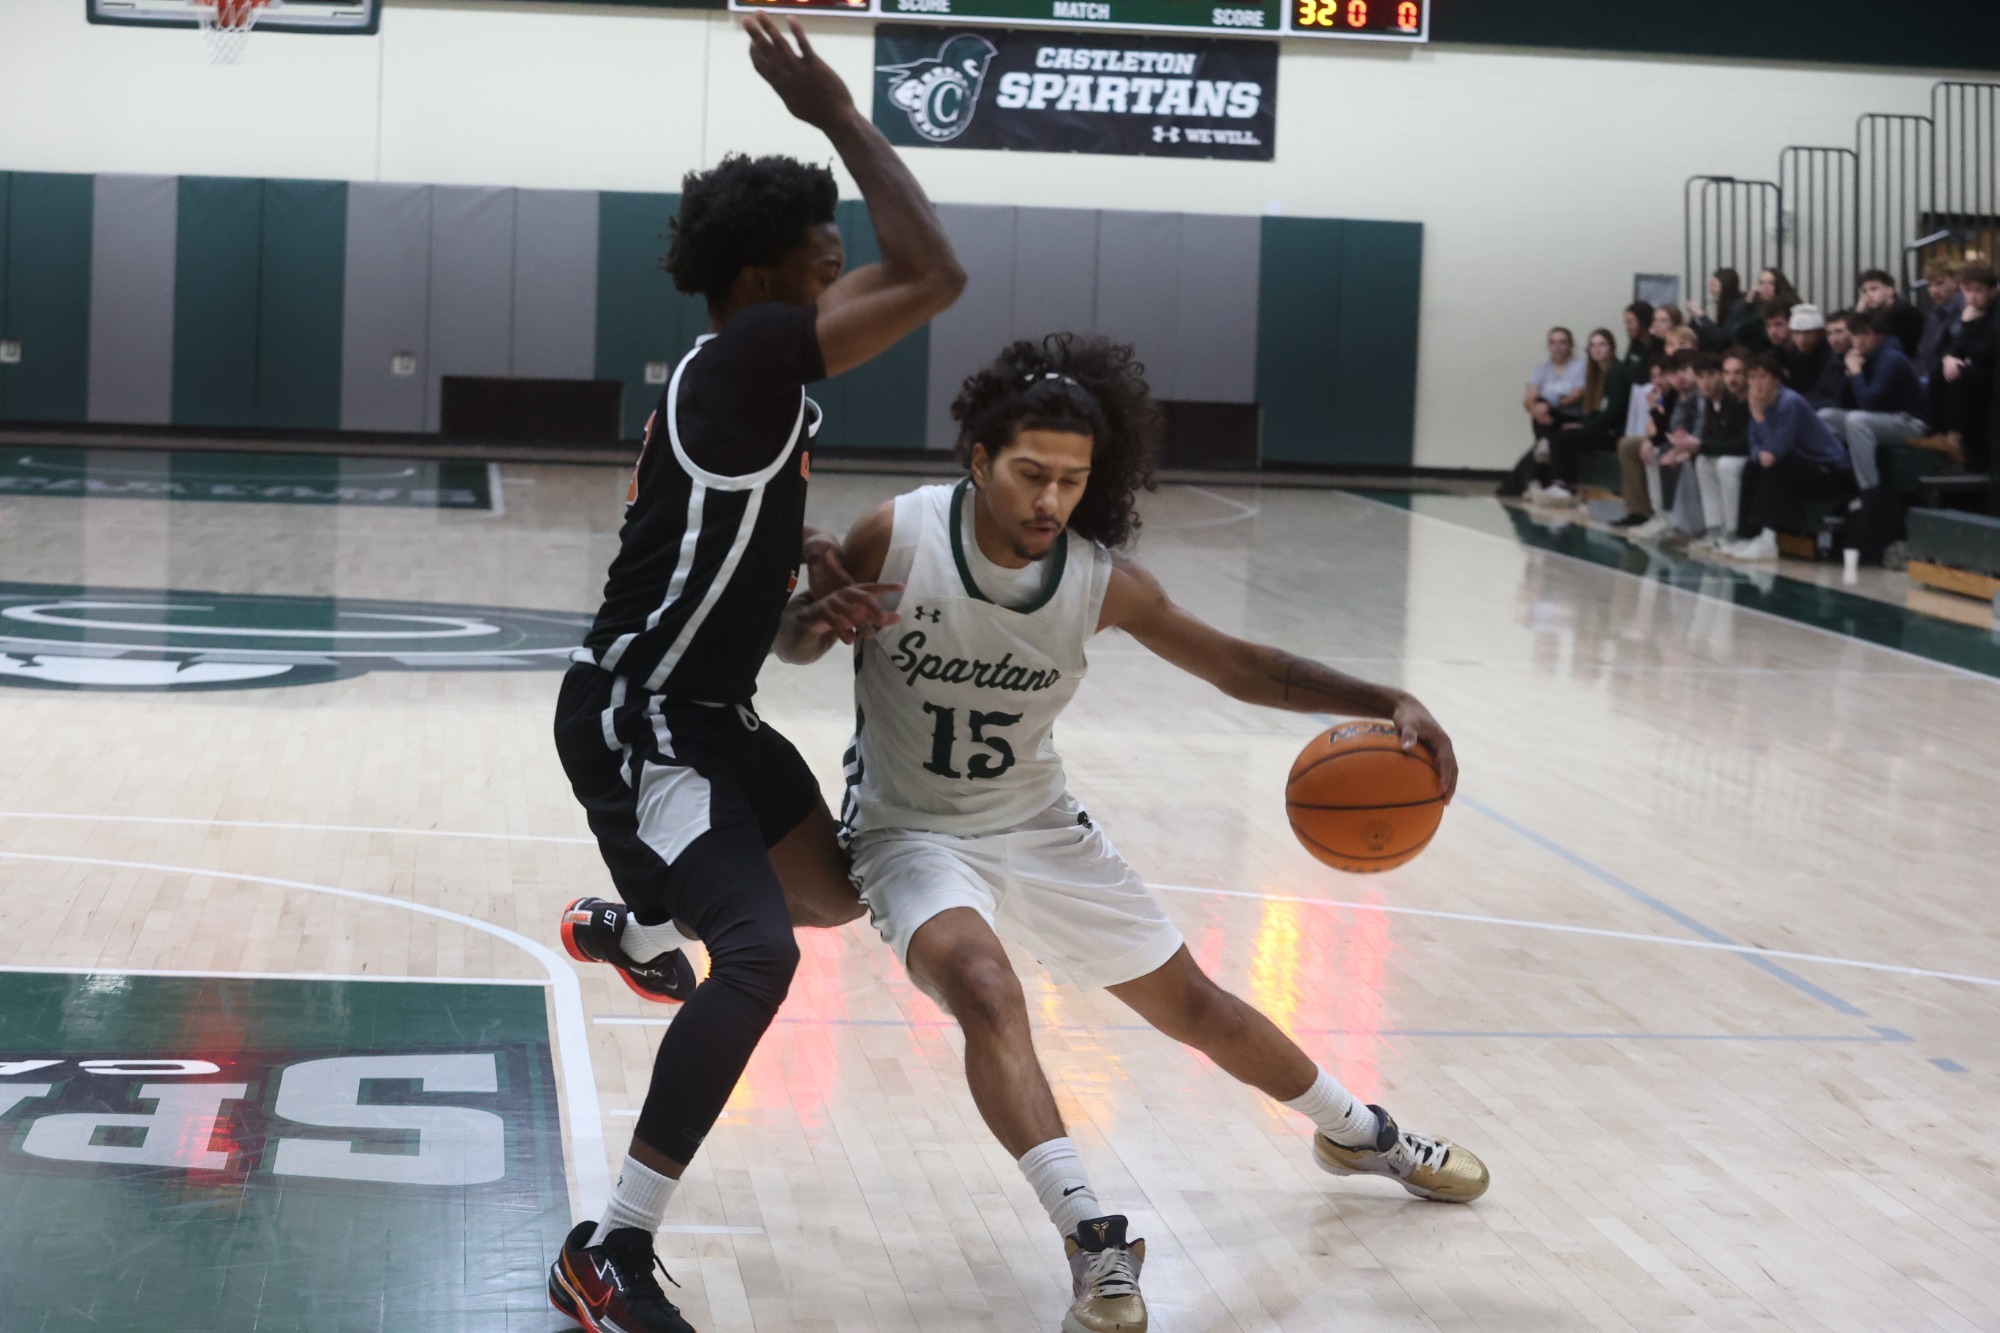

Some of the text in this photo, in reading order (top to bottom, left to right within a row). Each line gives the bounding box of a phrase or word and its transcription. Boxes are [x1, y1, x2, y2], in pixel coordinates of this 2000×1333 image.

[1053, 2, 1110, 20] MATCH
[1212, 8, 1265, 27] SCORE
[1299, 0, 1337, 26] 32
[1035, 47, 1196, 74] CASTLETON
[996, 71, 1261, 118] SPARTANS
[891, 630, 1061, 692] Spartans
[922, 701, 1024, 780] 15
